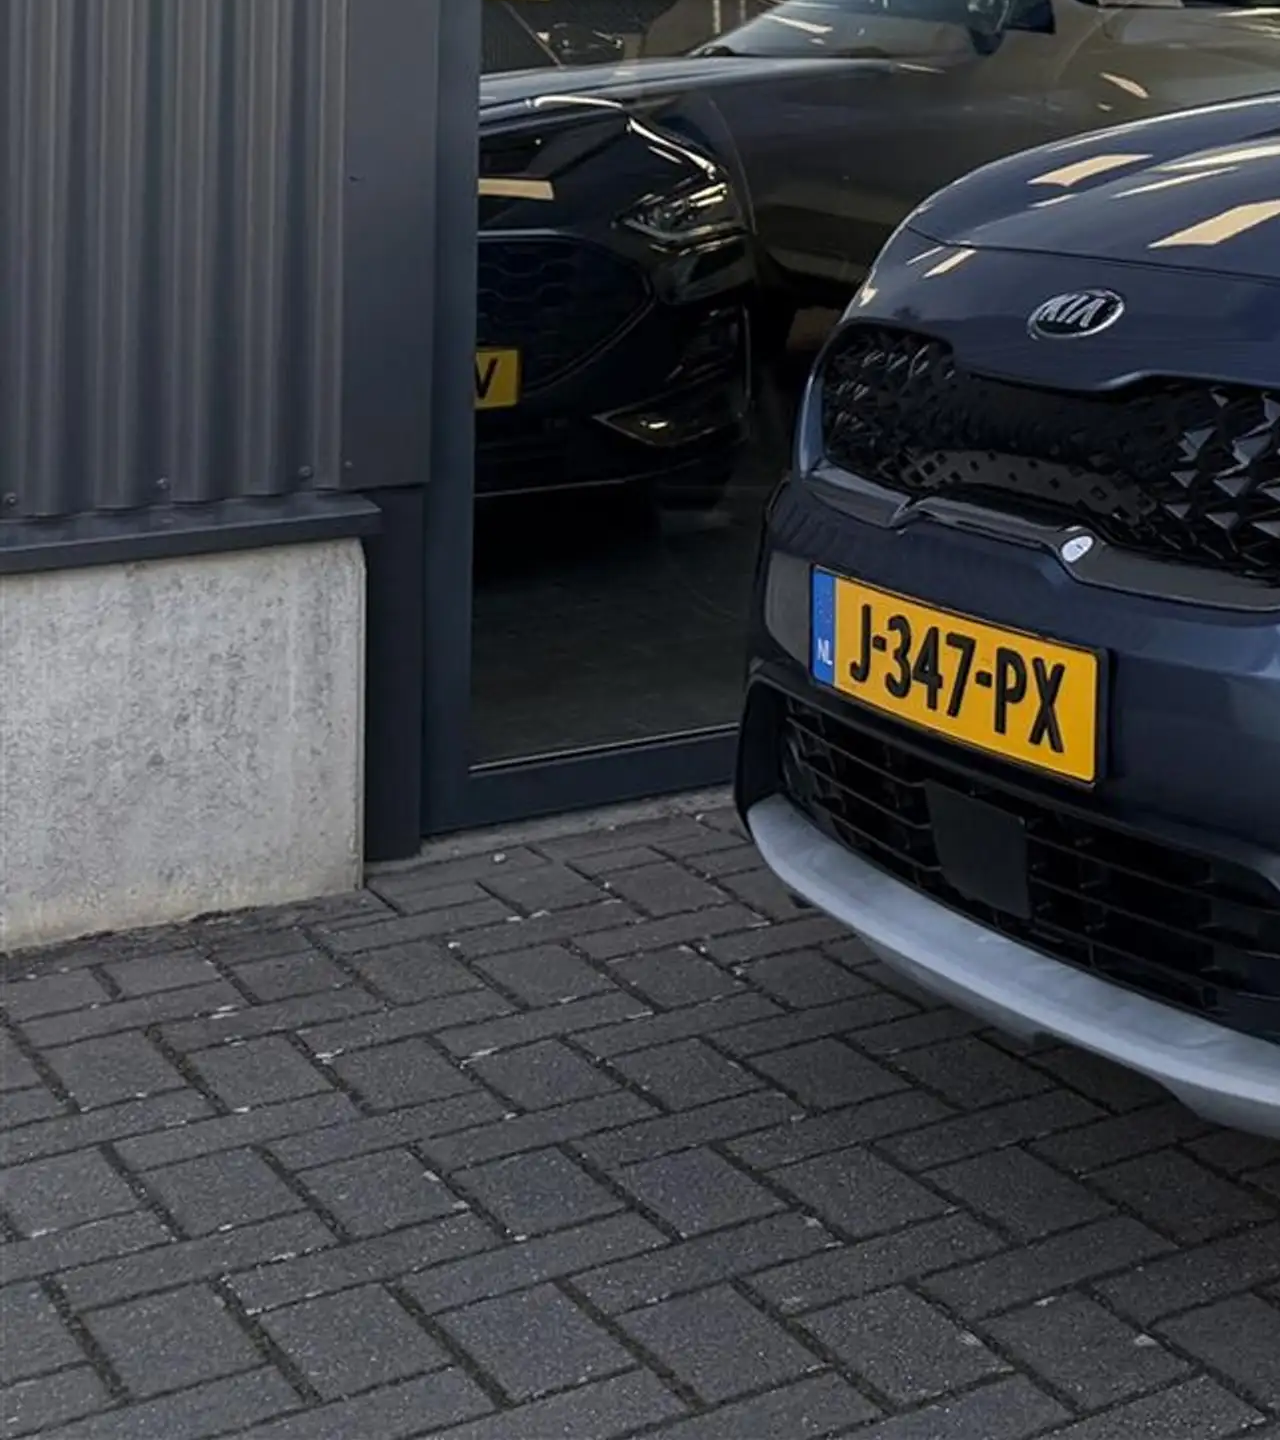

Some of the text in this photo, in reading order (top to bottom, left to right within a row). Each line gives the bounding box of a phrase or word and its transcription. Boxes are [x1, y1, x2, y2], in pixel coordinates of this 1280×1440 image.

[1038, 293, 1106, 328] KIA
[816, 637, 834, 667] NL
[849, 603, 1066, 754] J-347-PX
